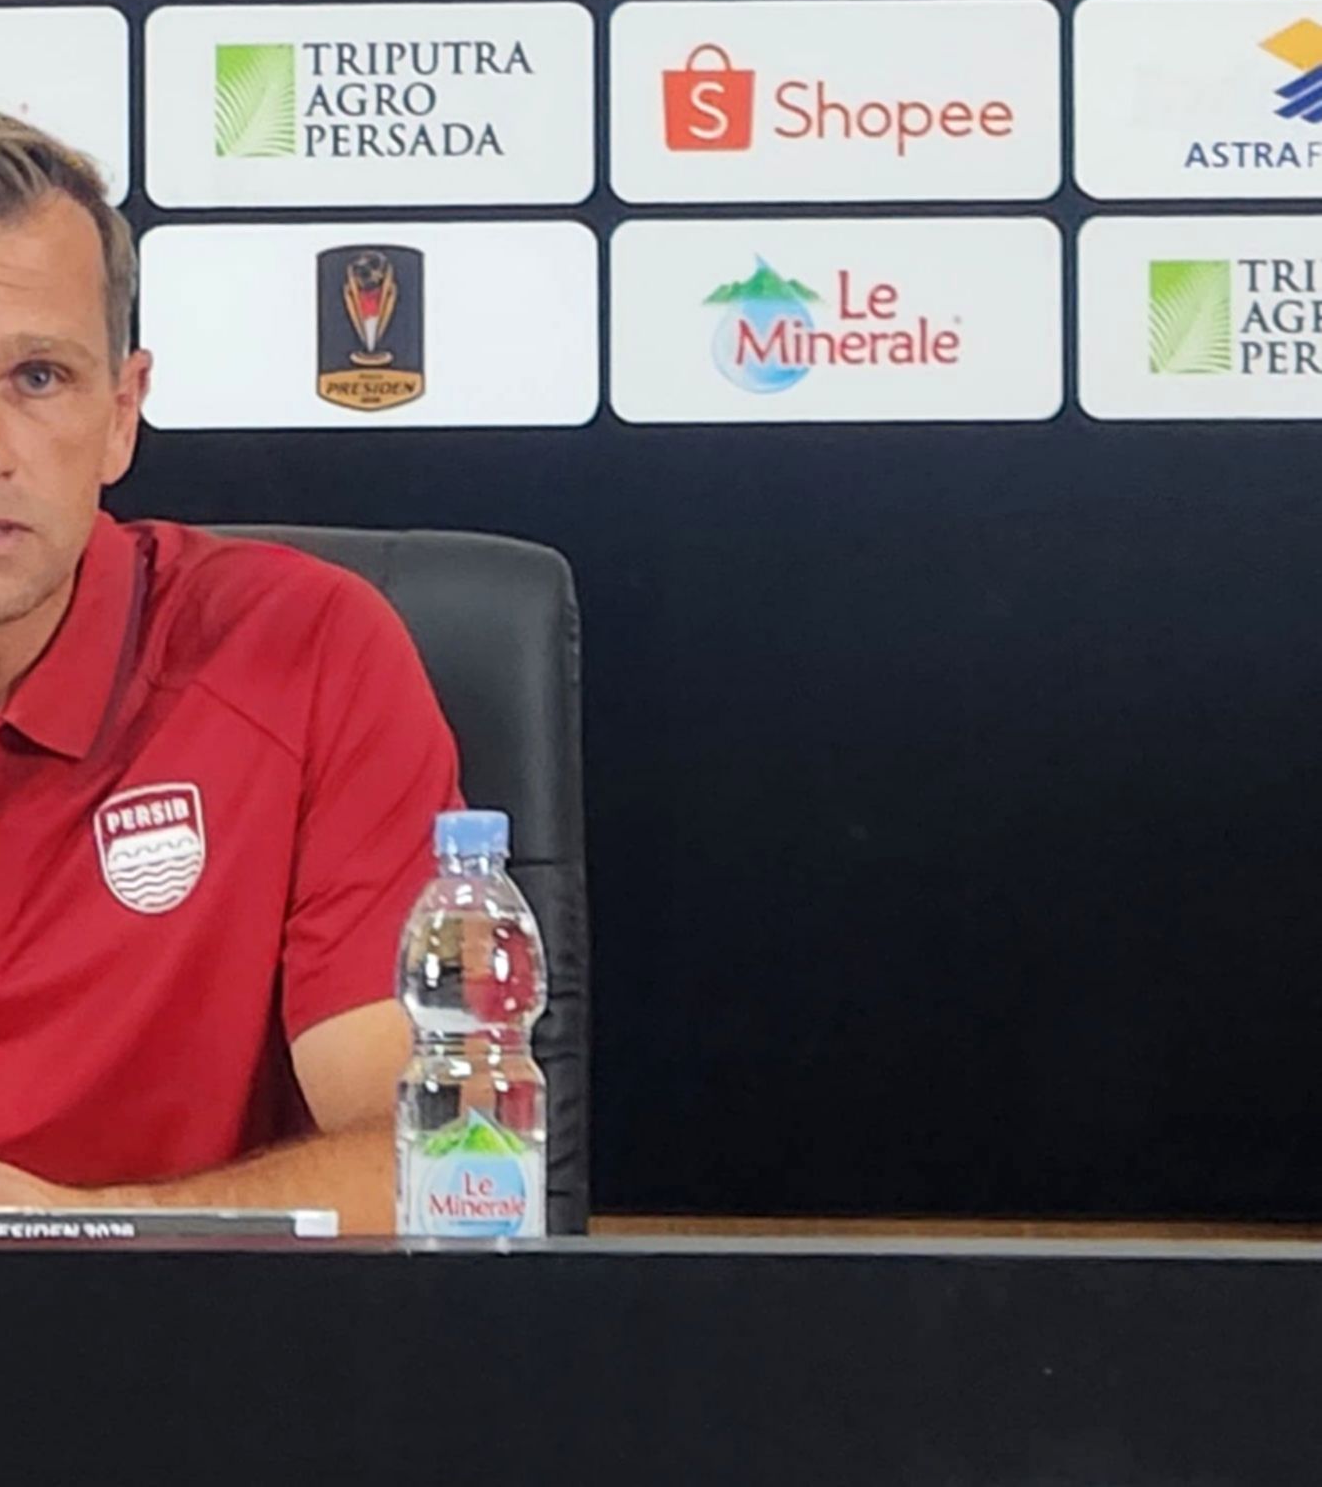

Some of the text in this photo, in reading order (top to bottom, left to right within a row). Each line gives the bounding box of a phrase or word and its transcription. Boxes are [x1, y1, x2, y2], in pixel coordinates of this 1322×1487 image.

[302, 41, 534, 76] TRIPUTRA
[304, 82, 437, 117] AGRO
[774, 81, 1013, 157] Shopee
[304, 123, 504, 157] PERSADA
[1184, 142, 1301, 168] ASTRA
[840, 273, 895, 320] Le
[736, 316, 957, 364] Minerale
[107, 797, 190, 835] PERSIB
[463, 1171, 493, 1197] Le
